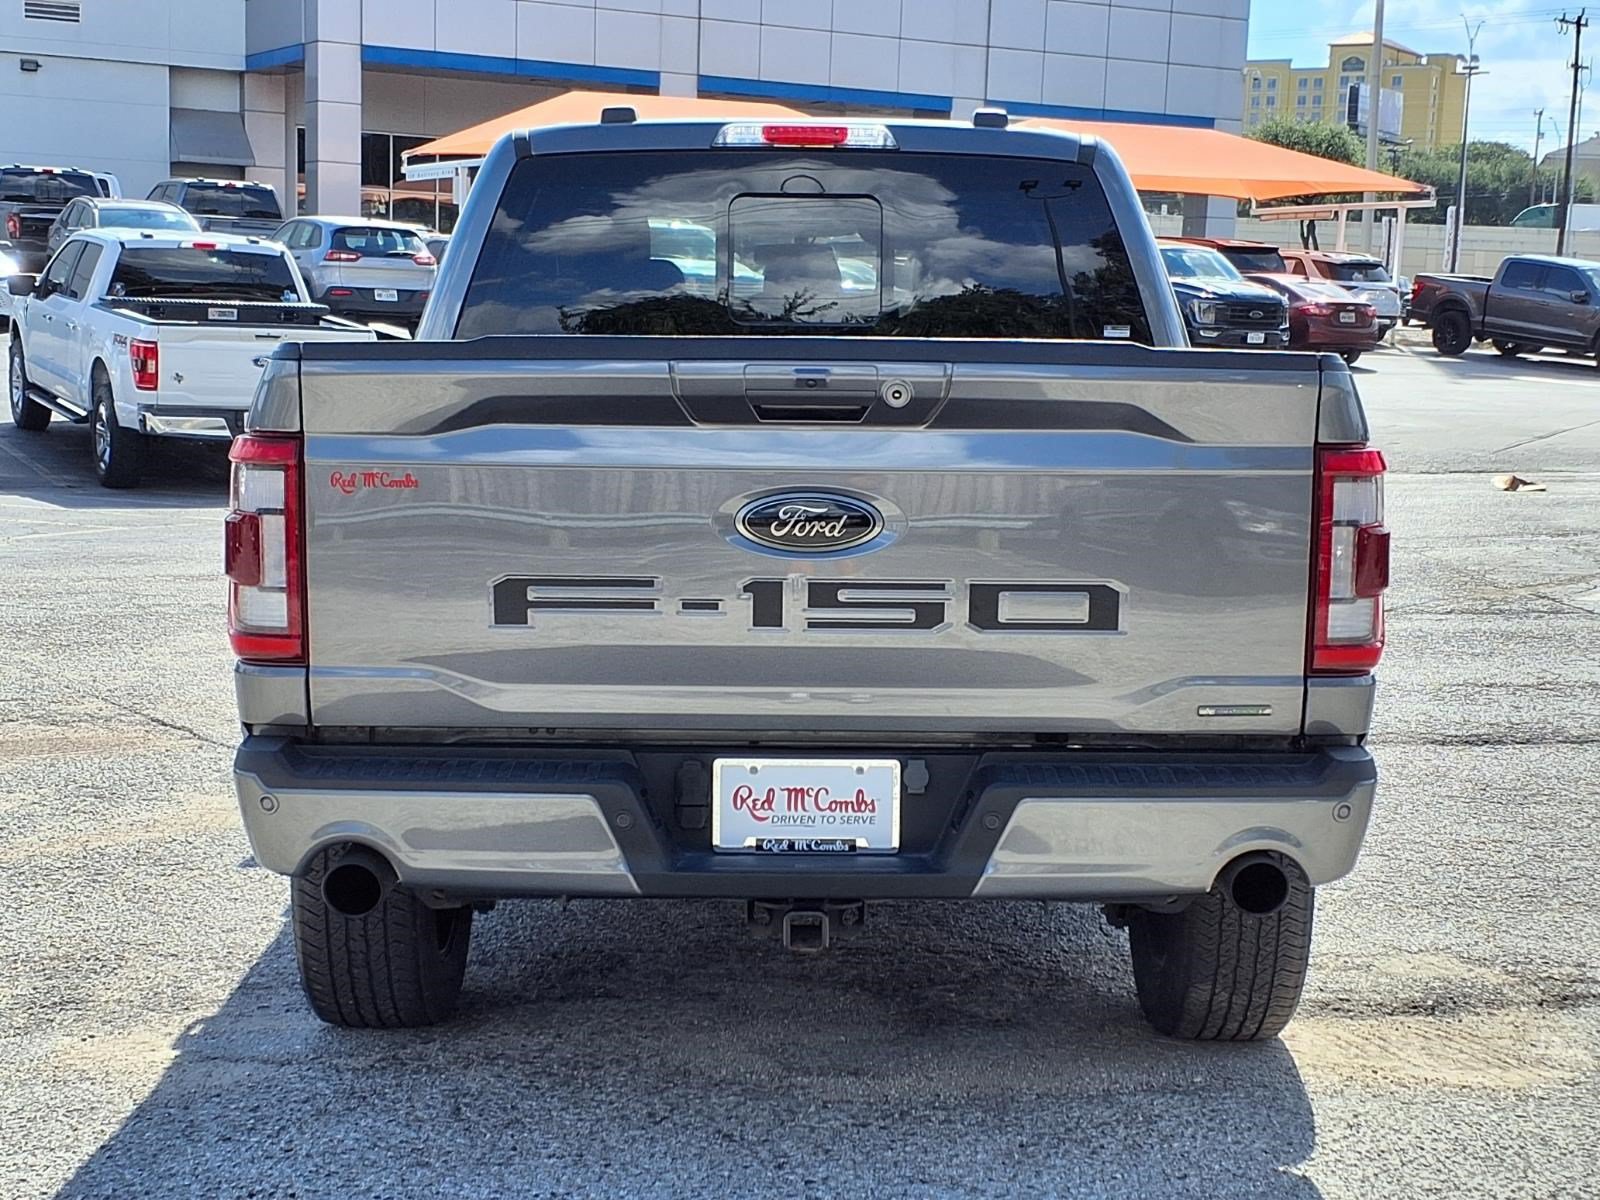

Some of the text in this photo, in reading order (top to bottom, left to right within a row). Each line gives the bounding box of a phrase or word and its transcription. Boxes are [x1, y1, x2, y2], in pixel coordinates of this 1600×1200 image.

[329, 471, 419, 495] Red McCombs
[769, 504, 850, 538] Ford
[487, 575, 1129, 635] F-150
[732, 784, 877, 823] Red McCombs
[770, 815, 877, 827] DRIVEN TO SERVE
[762, 838, 850, 853] Red McCombs
